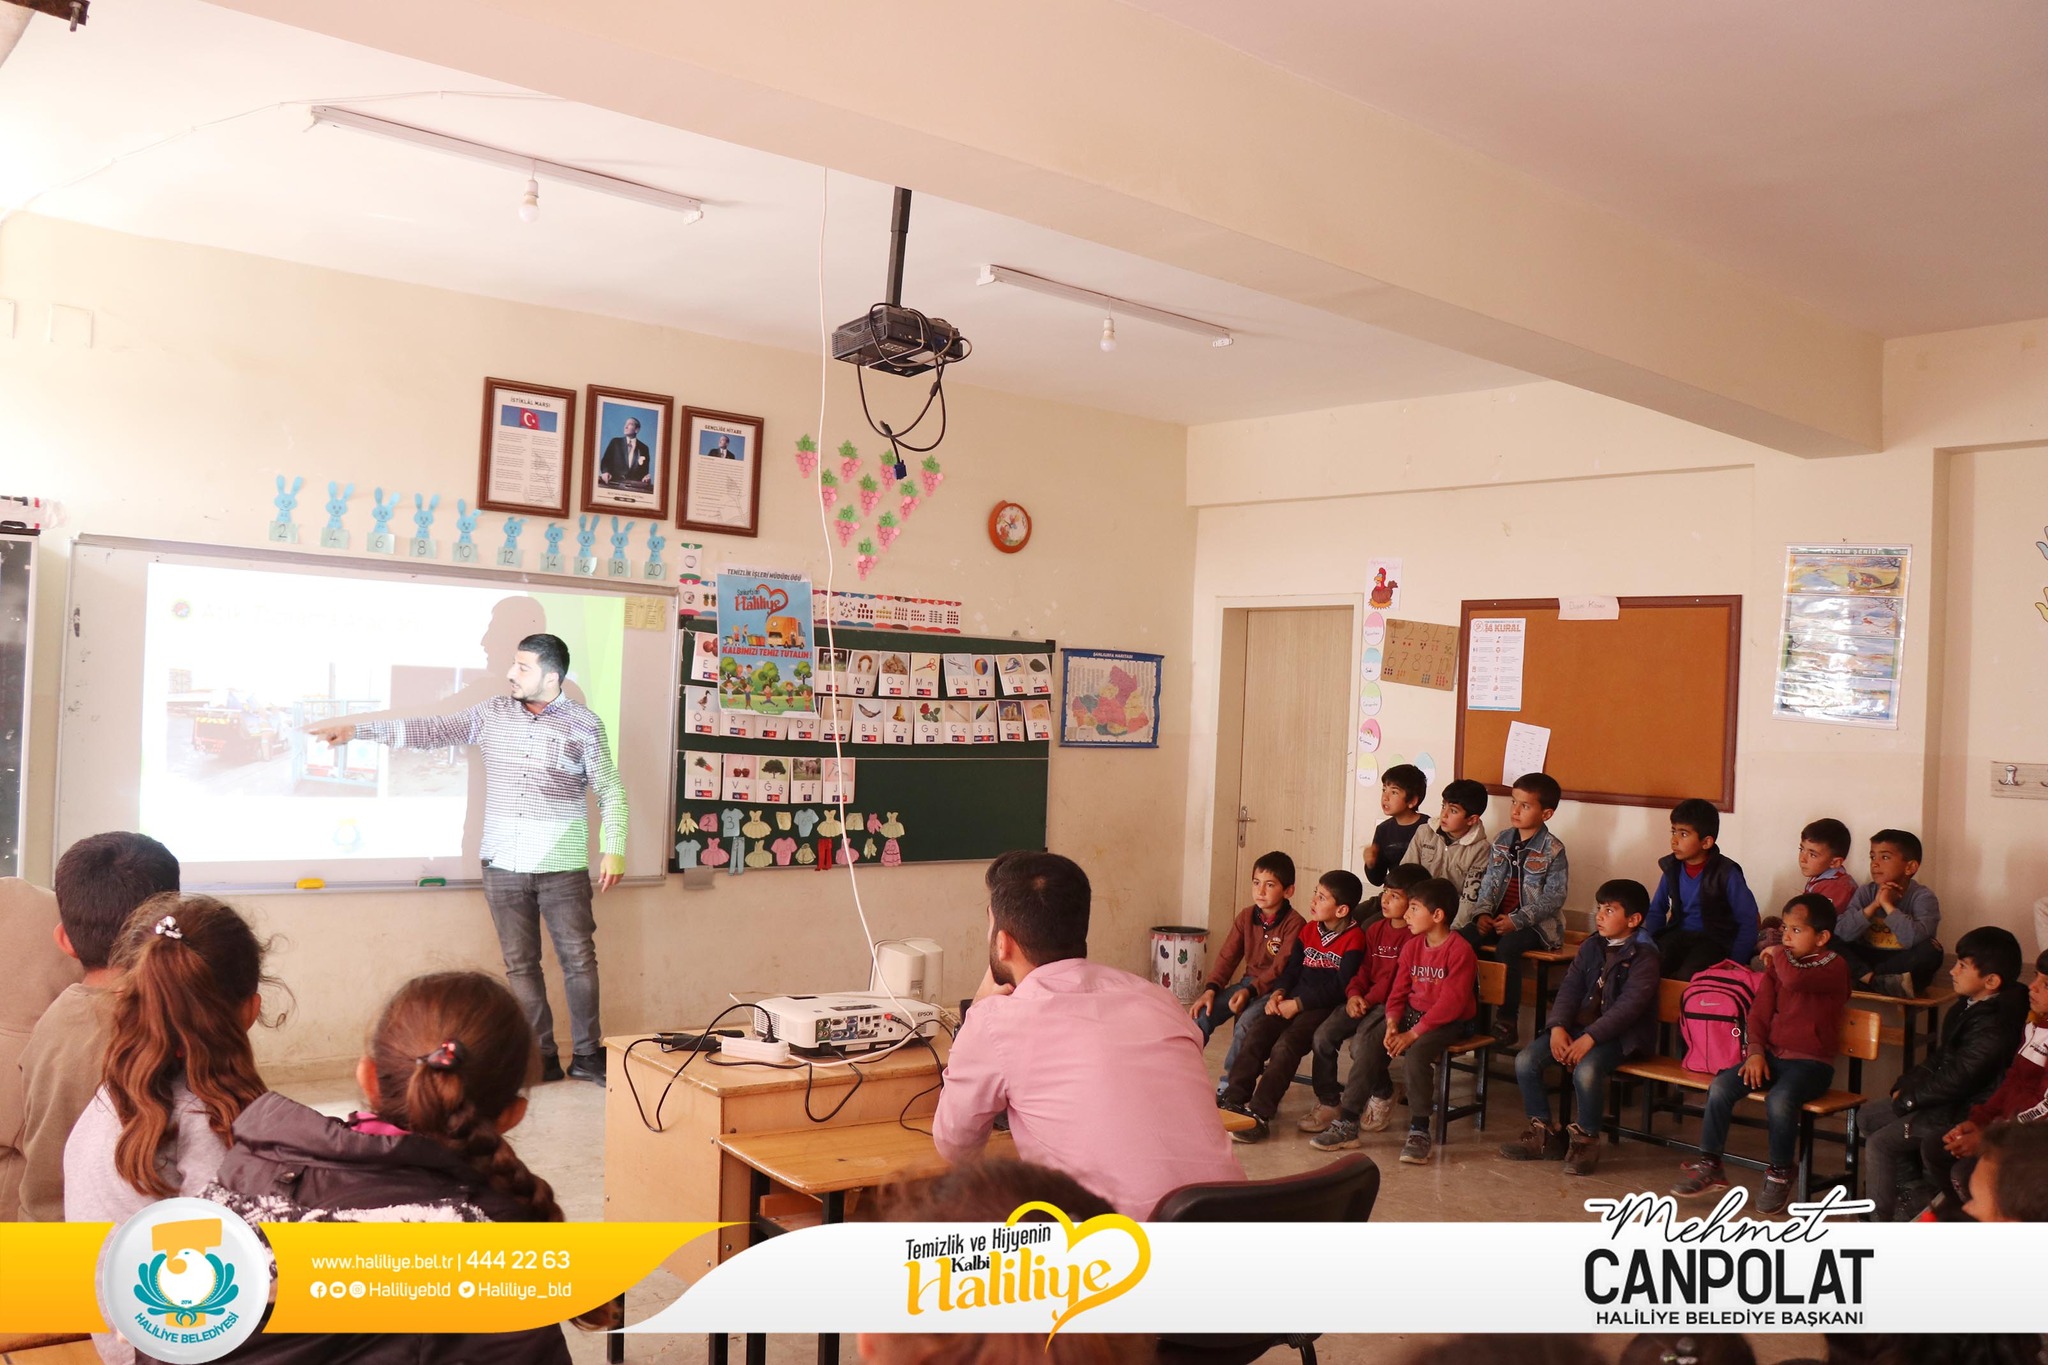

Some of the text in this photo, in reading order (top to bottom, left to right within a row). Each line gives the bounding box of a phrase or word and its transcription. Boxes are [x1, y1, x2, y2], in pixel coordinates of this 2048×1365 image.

[278, 524, 288, 538] 2
[375, 535, 384, 548] 6
[417, 540, 426, 556] 8
[459, 545, 472, 558] 10
[504, 550, 514, 564] 12
[546, 557, 556, 569] 14
[580, 560, 590, 573] 16
[613, 560, 624, 574] 18
[648, 564, 661, 576] 20
[1404, 622, 1414, 640] 2
[1420, 622, 1429, 642] 3
[1494, 624, 1522, 632] KURAL
[1412, 653, 1421, 672] 8
[854, 676, 860, 685] N
[887, 676, 894, 685] O
[916, 678, 922, 686] M
[977, 678, 980, 686] T
[731, 716, 736, 724] R
[797, 720, 814, 729] D d
[873, 724, 878, 732] b
[892, 725, 898, 733] Z
[695, 779, 713, 787] H h
[732, 781, 738, 789] V
[801, 783, 815, 794] F f
[834, 784, 838, 793] J
[704, 817, 712, 826] 2
[726, 816, 735, 829] 3
